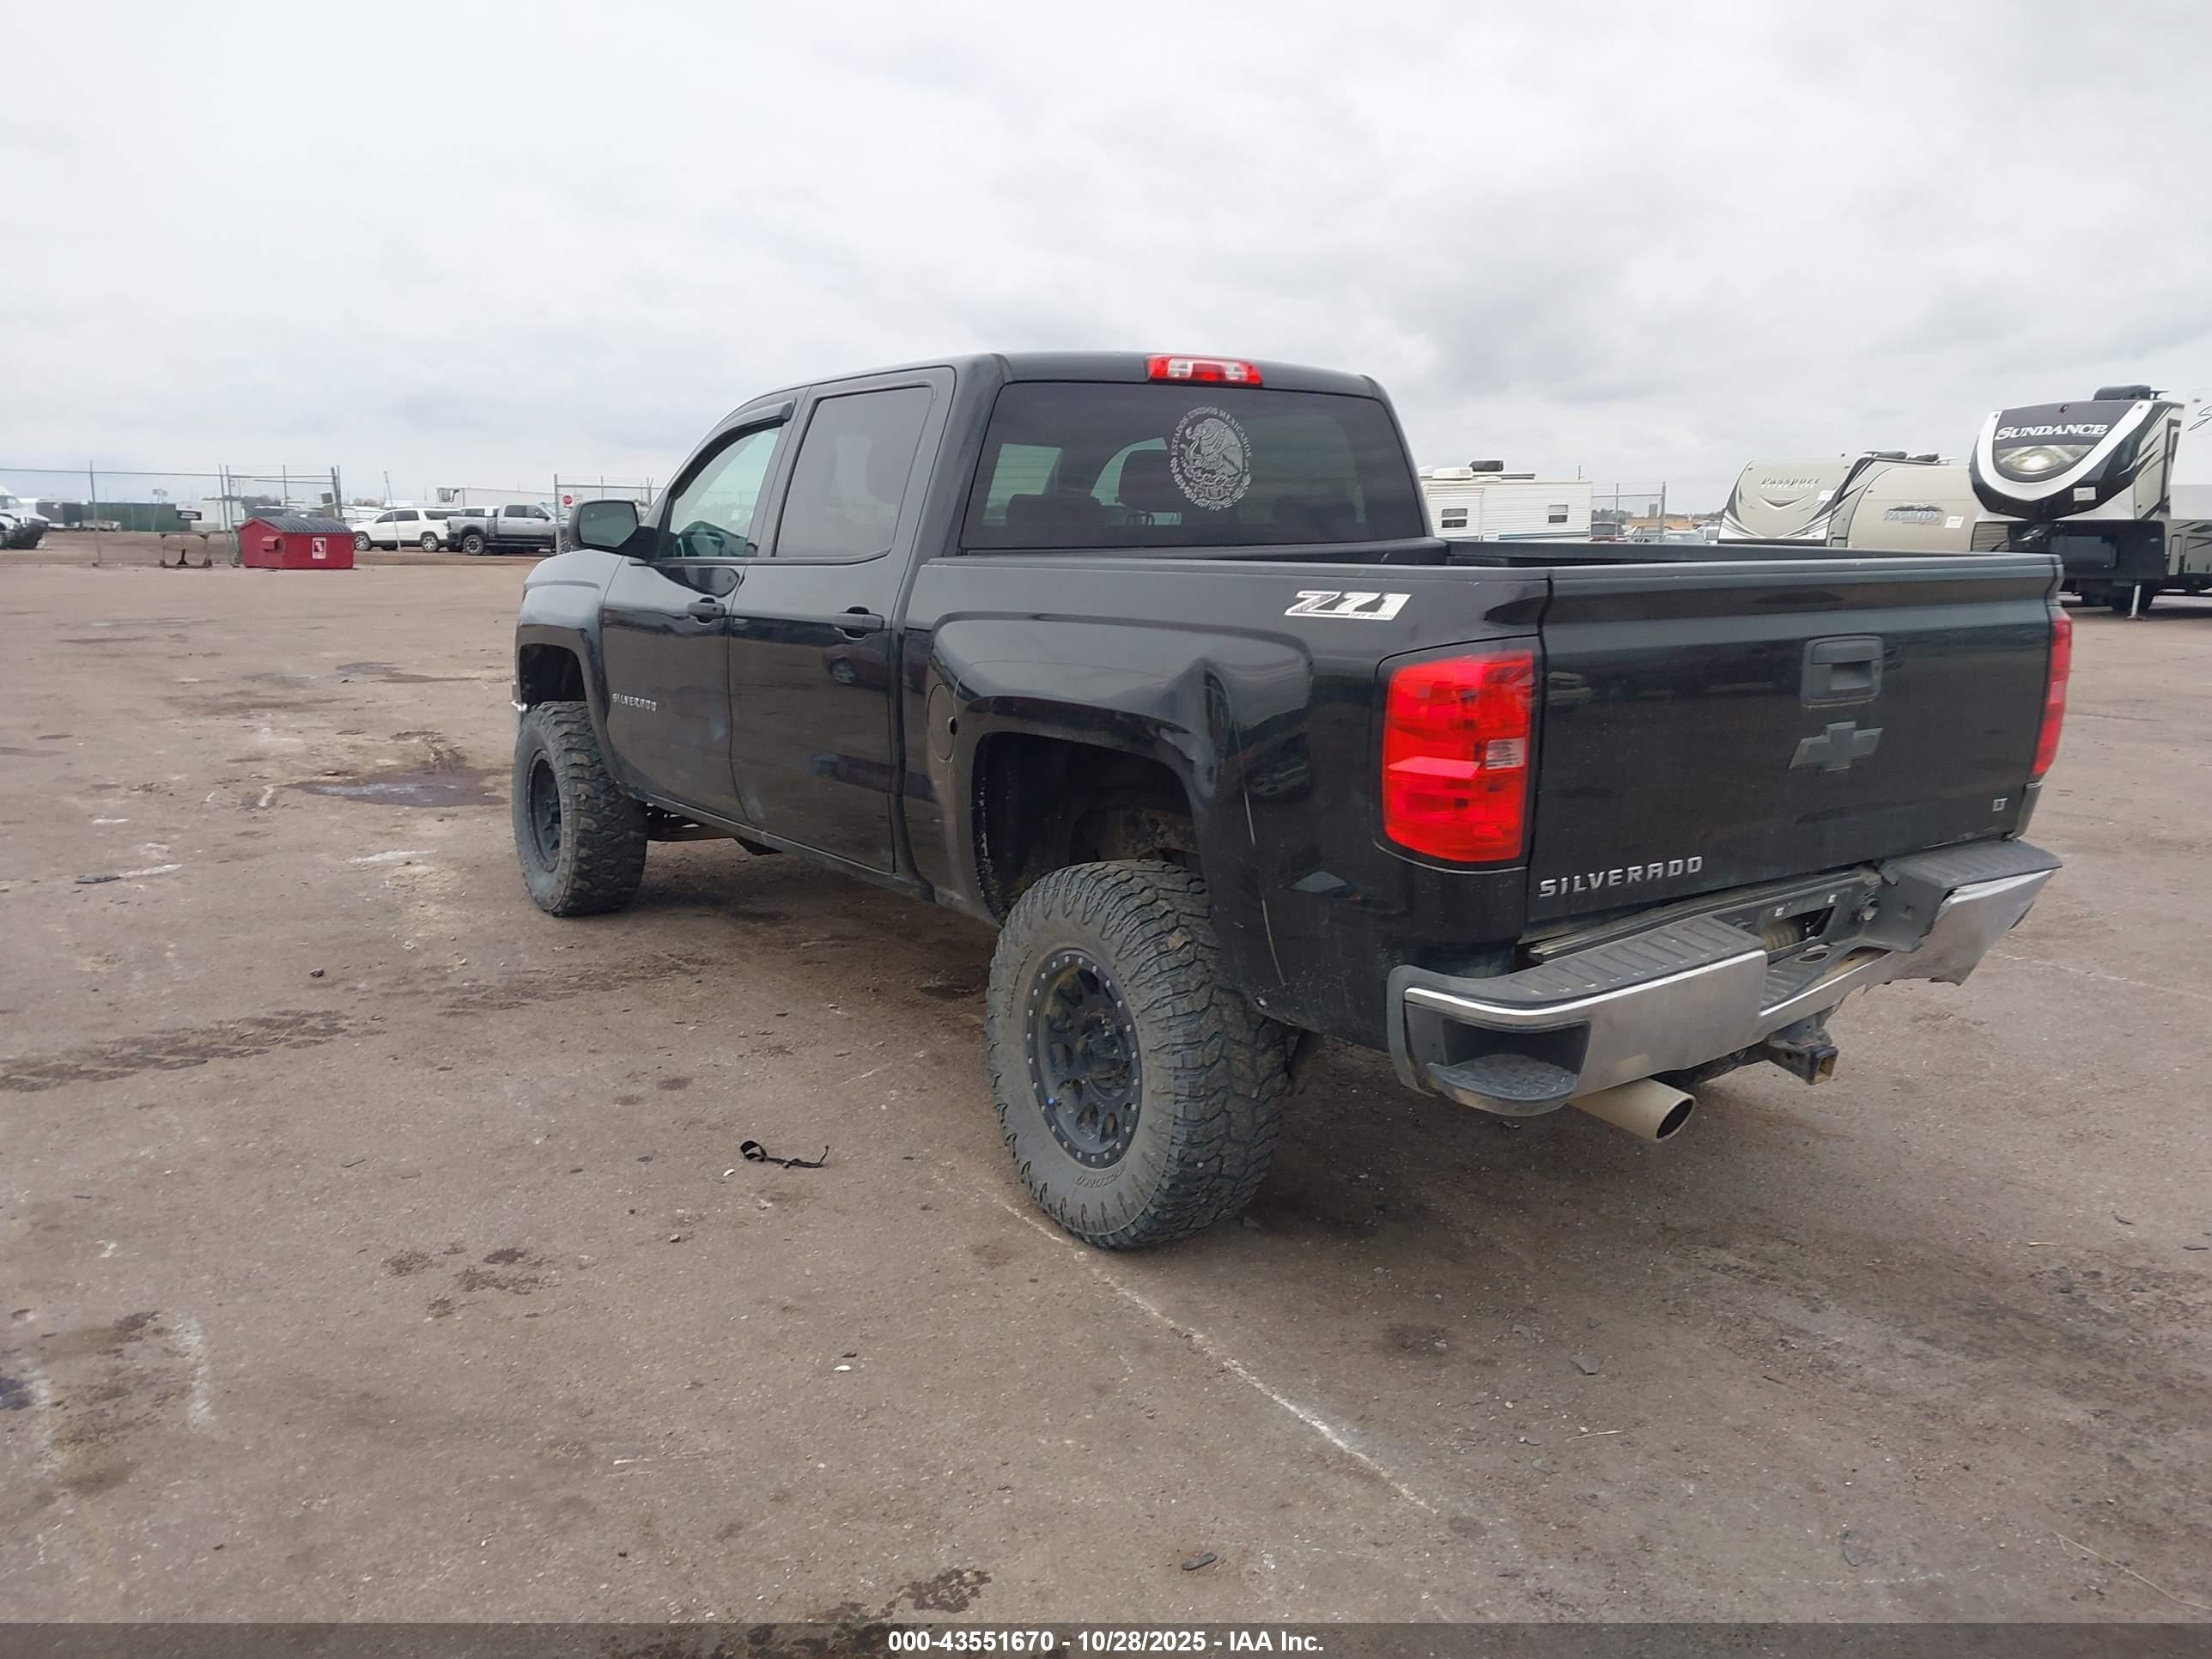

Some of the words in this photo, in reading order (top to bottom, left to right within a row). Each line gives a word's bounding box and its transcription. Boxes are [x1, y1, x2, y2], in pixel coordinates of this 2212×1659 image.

[1219, 410, 1252, 458] MEXICANOS
[1994, 424, 2109, 440] SUNDANCE
[1760, 477, 1820, 487] Passport
[1285, 590, 1411, 620] Z71
[612, 693, 657, 711] SILVERADO
[1539, 856, 1704, 898] SILVERADO
